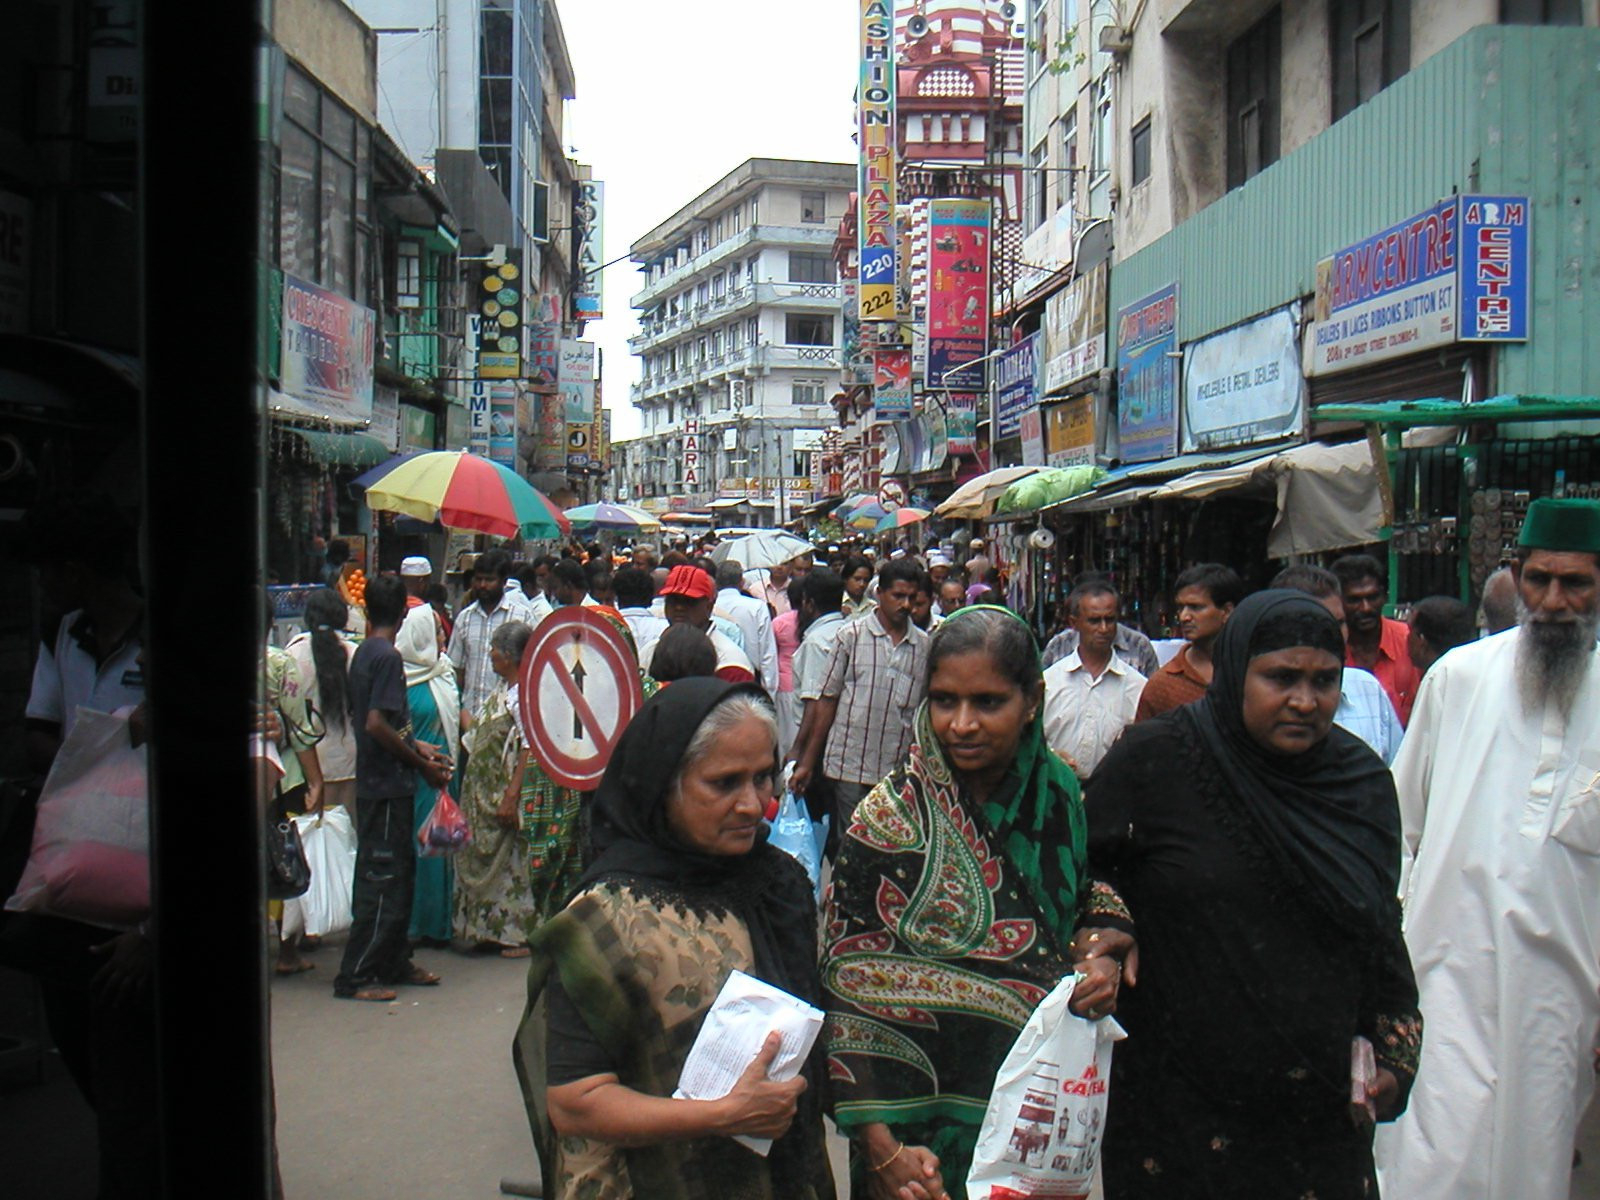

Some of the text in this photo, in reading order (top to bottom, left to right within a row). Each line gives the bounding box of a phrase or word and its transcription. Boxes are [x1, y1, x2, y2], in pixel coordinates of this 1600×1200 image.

[865, 145, 891, 248] PLAZA
[1465, 202, 1523, 225] ARM
[863, 253, 893, 279] 220
[1478, 227, 1511, 332] CENTRE
[287, 285, 345, 337] CRESCENT
[862, 290, 893, 315] 222
[1317, 322, 1341, 346] DEALERS
[1341, 321, 1348, 339] IN
[1404, 291, 1436, 320] BUTTON
[287, 328, 339, 366] TRADERS
[685, 420, 697, 483] HARA
